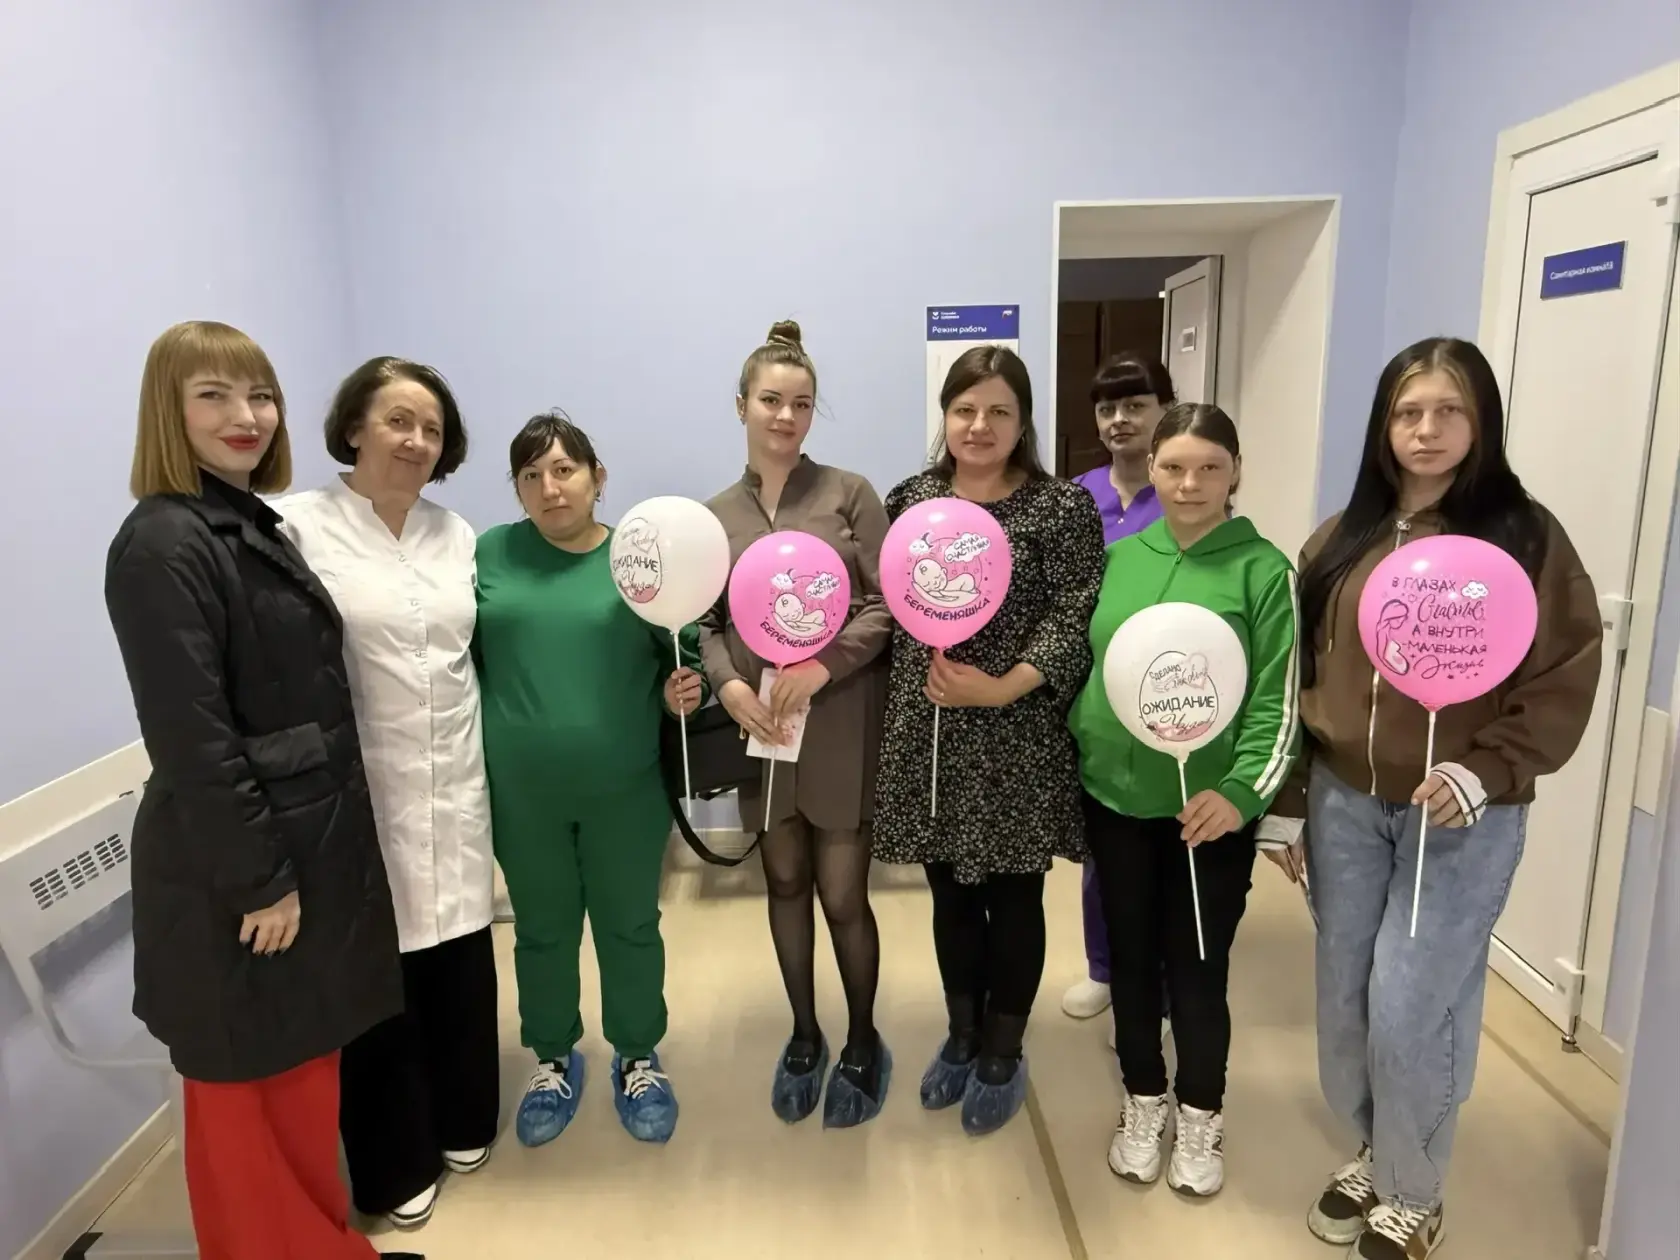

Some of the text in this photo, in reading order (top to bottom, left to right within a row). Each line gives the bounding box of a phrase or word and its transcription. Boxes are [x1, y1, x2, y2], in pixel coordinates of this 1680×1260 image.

[932, 325, 987, 334] Режим работы
[1392, 577, 1457, 593] В ГЛАЗАХ
[903, 594, 991, 621] БЕРЕМЕНЯШКА
[760, 620, 834, 648] БЕРЕМЕНЯШКА
[1411, 624, 1485, 639] А ВНУТРИ
[1148, 664, 1182, 681] СДЕЛАНО
[1141, 695, 1216, 716] ОЖИДАНИЕ
